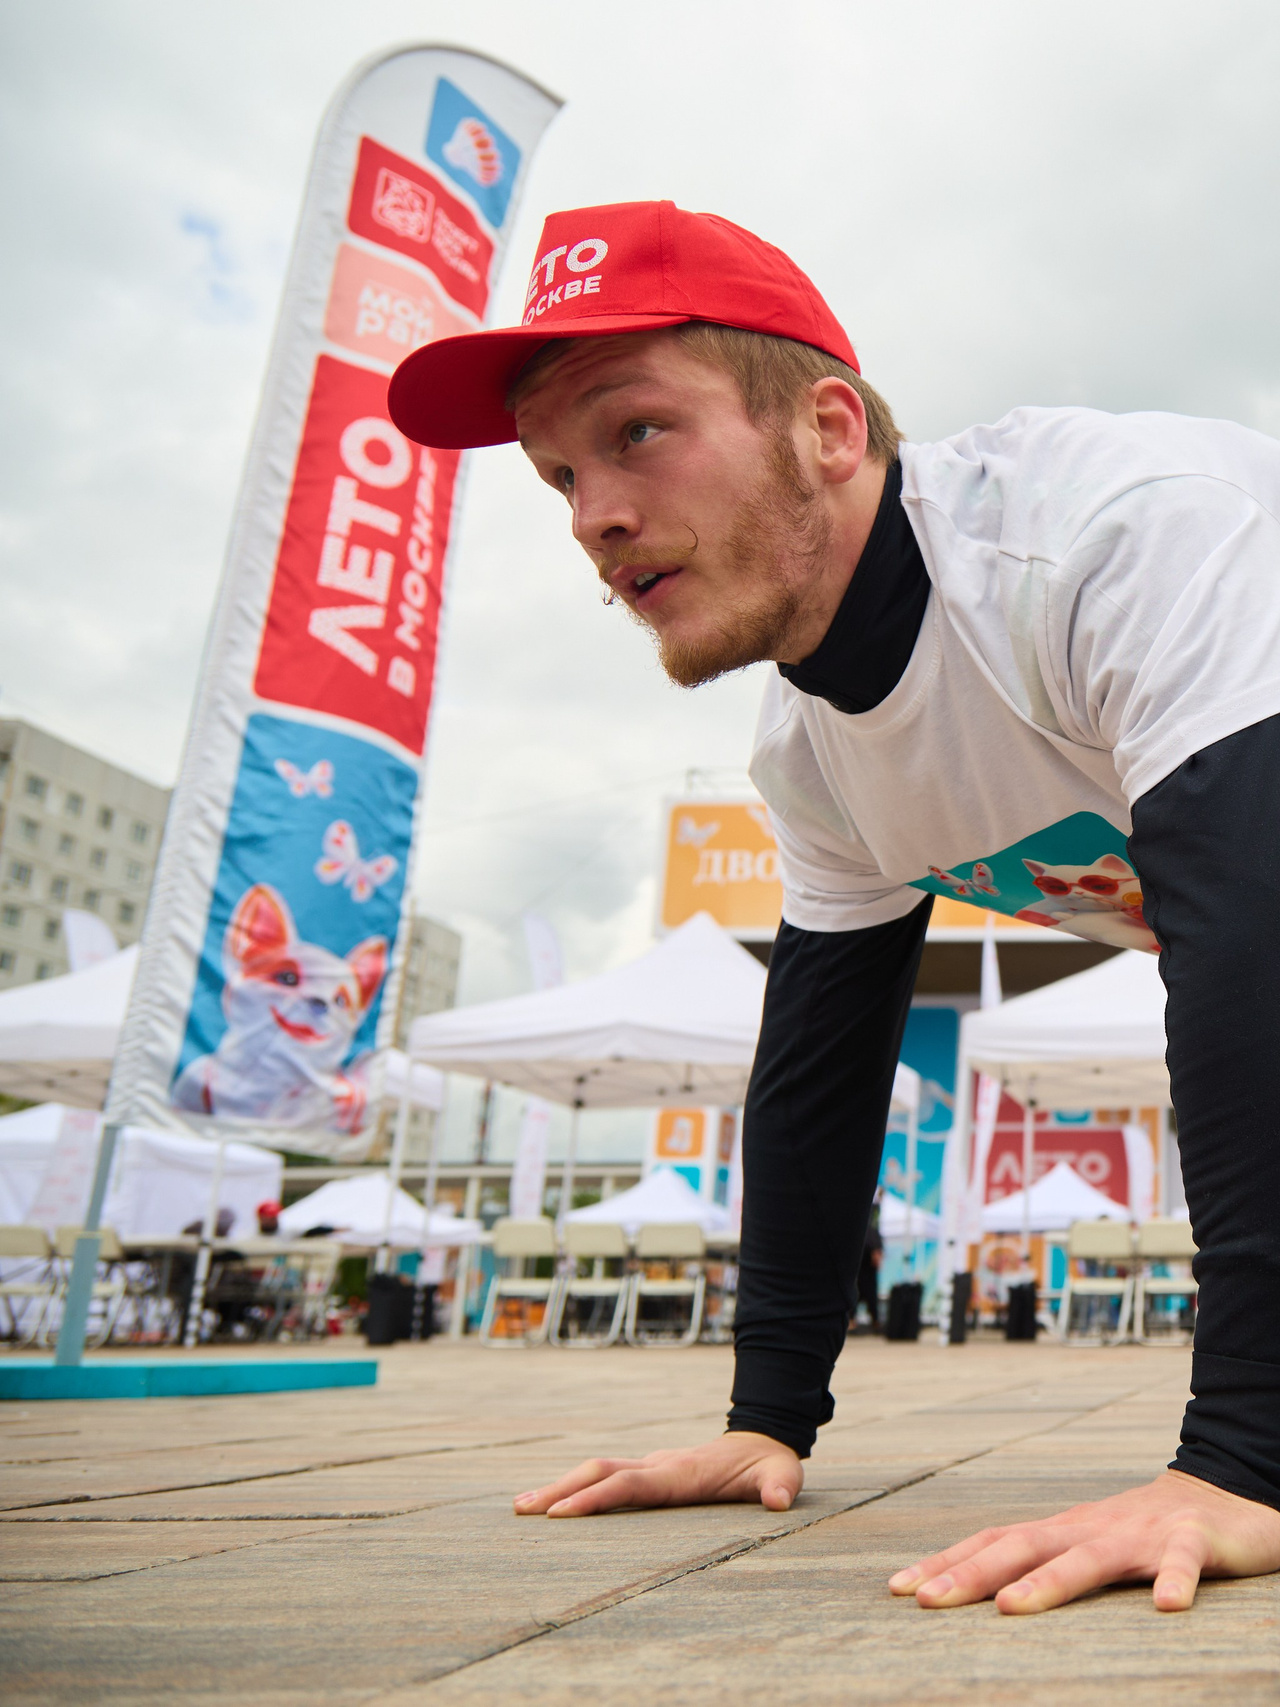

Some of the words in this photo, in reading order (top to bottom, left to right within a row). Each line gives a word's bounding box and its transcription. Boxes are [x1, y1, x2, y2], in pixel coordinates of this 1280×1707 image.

[526, 238, 609, 309] ЕТО
[522, 275, 602, 326] ОСКВЕ
[307, 416, 413, 677] ЛЕТО
[386, 655, 417, 698] В
[692, 848, 782, 887] ДВО
